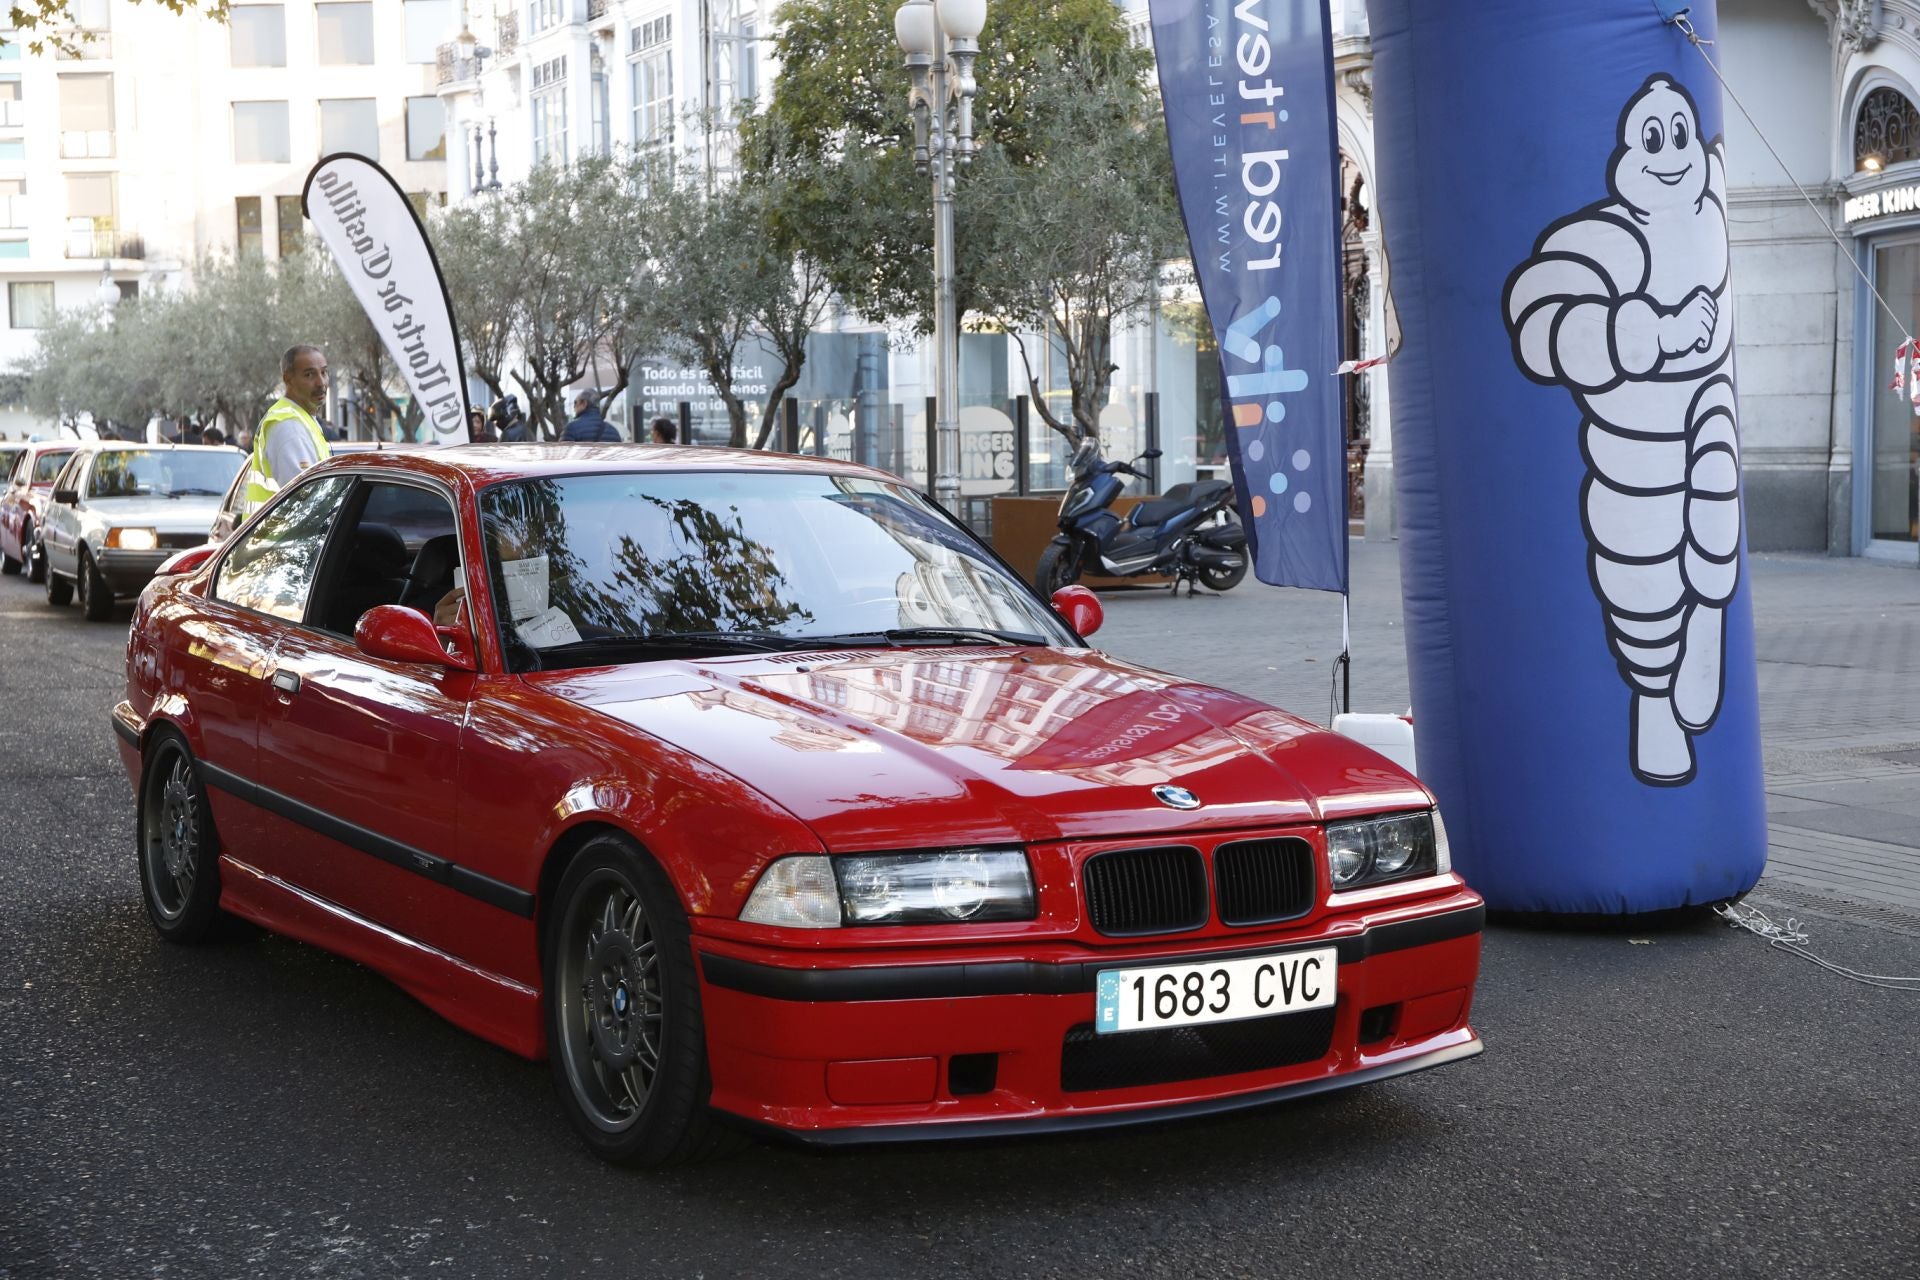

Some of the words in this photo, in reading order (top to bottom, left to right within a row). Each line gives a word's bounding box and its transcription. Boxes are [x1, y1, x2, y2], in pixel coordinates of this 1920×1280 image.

[641, 366, 678, 380] Todo
[680, 369, 697, 380] es
[731, 366, 764, 380] fácil
[642, 382, 696, 396] cuando
[697, 382, 768, 396] hamos
[643, 398, 657, 412] el
[660, 398, 707, 411] mimo
[1133, 968, 1231, 1022] 1683
[1254, 957, 1321, 1009] CVC
[1103, 1007, 1114, 1022] E
